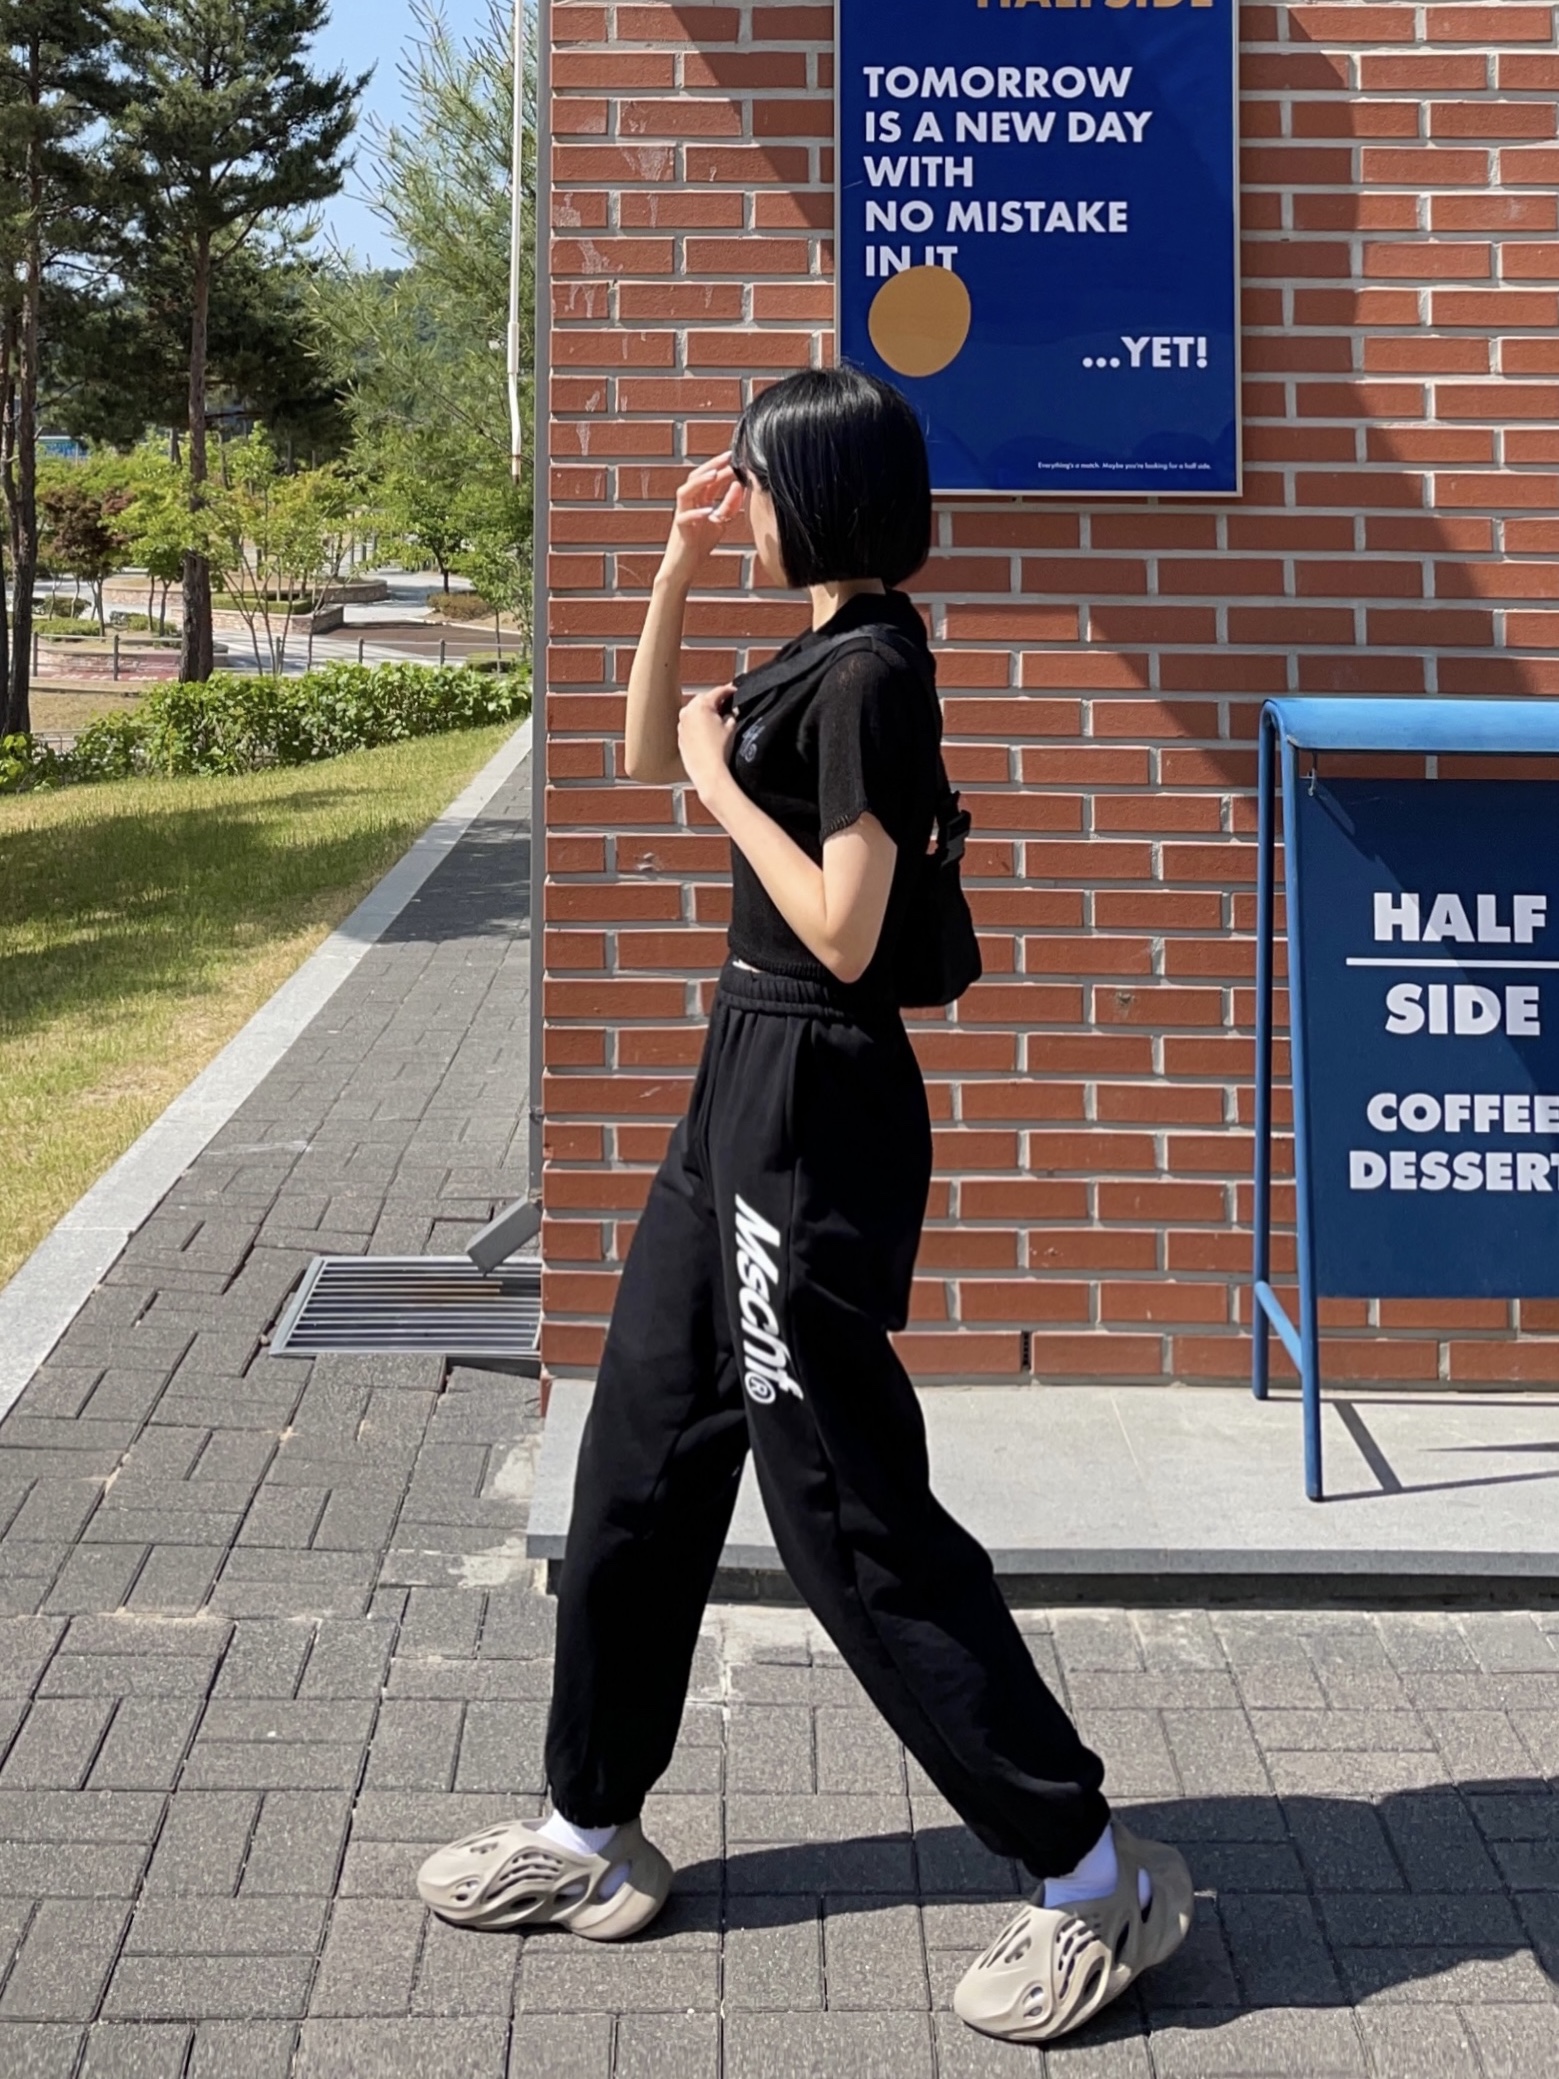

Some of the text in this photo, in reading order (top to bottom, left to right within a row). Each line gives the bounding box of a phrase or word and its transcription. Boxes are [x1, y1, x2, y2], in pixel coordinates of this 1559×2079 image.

[863, 66, 1133, 99] TOMORROW
[865, 110, 1153, 143] IS A NEW DAY
[863, 156, 973, 188] WITH
[865, 200, 1128, 233] NO MISTAKE
[865, 245, 958, 277] IN IT
[1082, 336, 1208, 369] ...YET!
[1037, 461, 1074, 471] Everything's
[1081, 462, 1100, 470] match.
[1102, 462, 1124, 471] Maybe
[1125, 462, 1144, 471] you're
[1145, 462, 1168, 471] looking
[1169, 462, 1178, 470] for
[1184, 462, 1197, 470] half
[1373, 892, 1547, 944] HALF
[1385, 983, 1541, 1036] SIDE
[1366, 1092, 1559, 1134] COFFEE
